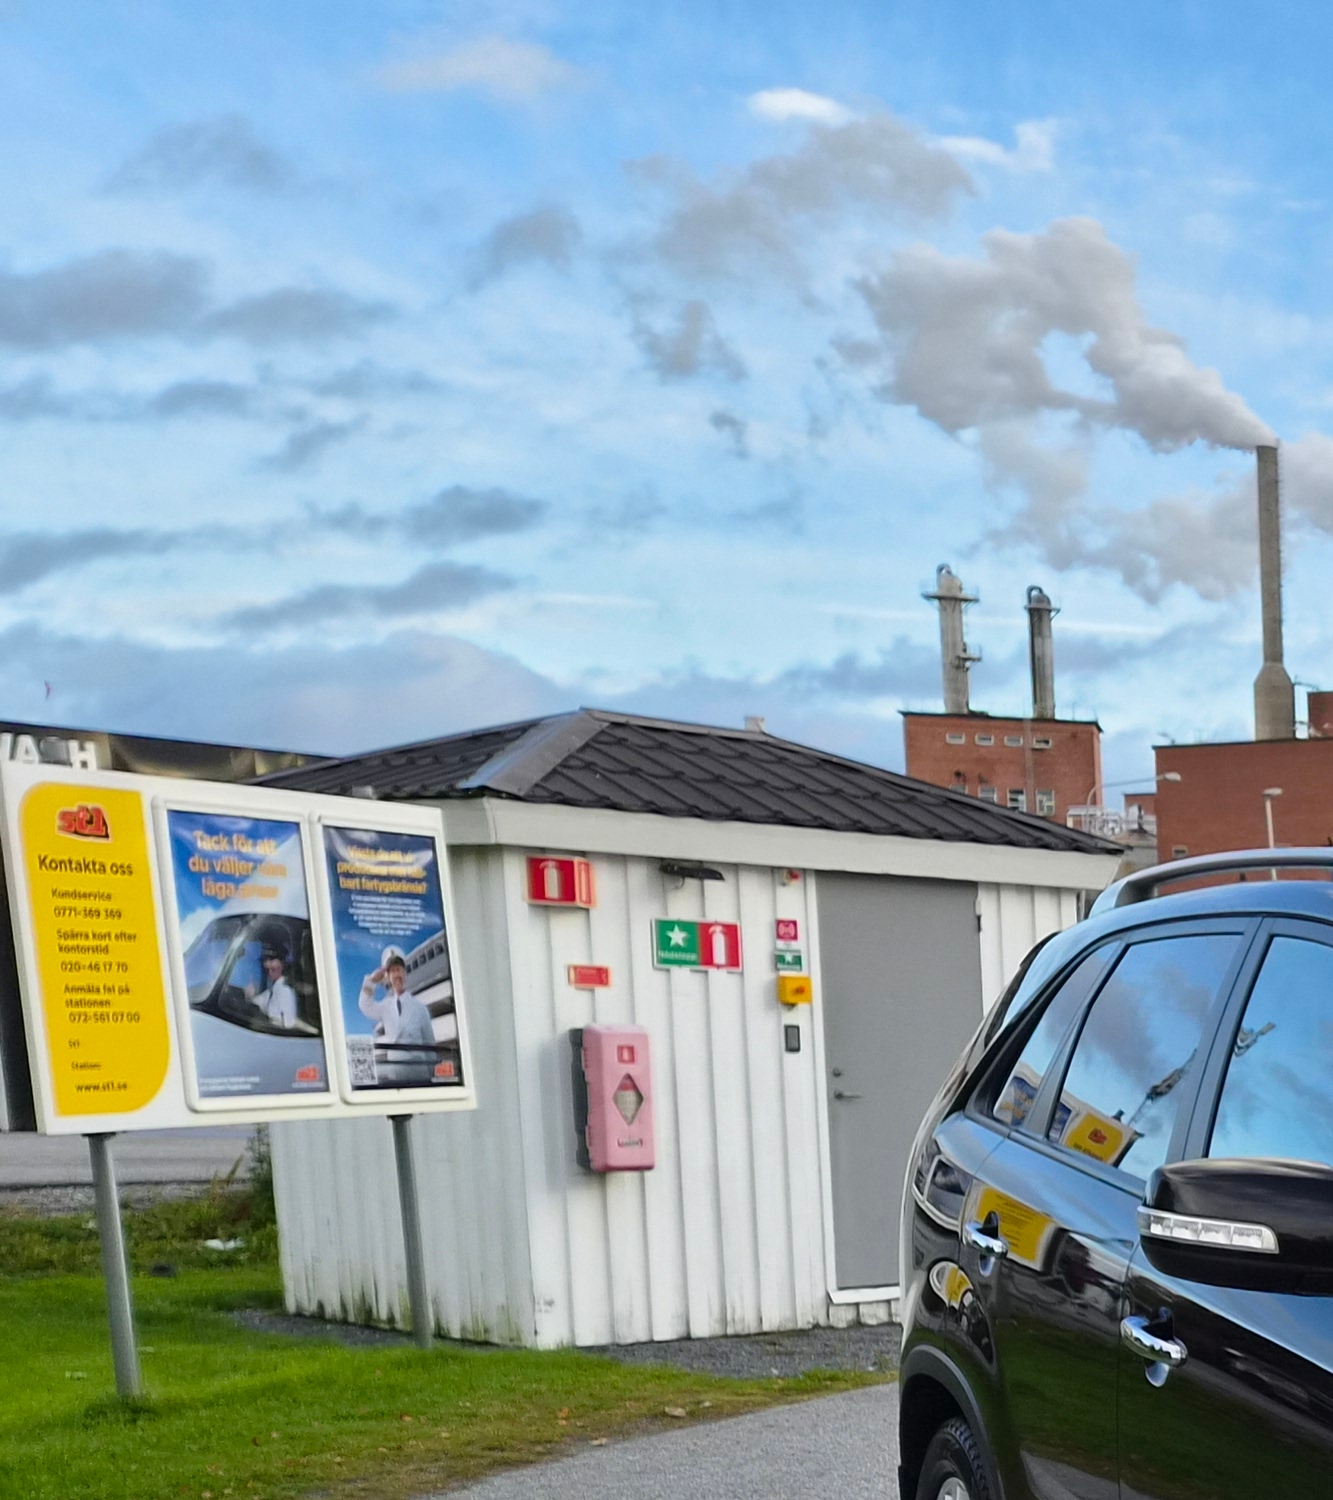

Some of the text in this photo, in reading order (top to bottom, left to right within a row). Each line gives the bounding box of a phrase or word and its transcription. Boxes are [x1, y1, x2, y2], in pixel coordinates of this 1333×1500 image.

[38, 854, 133, 876] Kontakta oss
[188, 853, 209, 872] du
[51, 887, 112, 902] Kundservice
[103, 907, 122, 920] 369
[56, 927, 137, 942] Spärra kort efter
[57, 943, 109, 955] kontorstid
[102, 960, 113, 973] 17
[115, 961, 128, 973] 70
